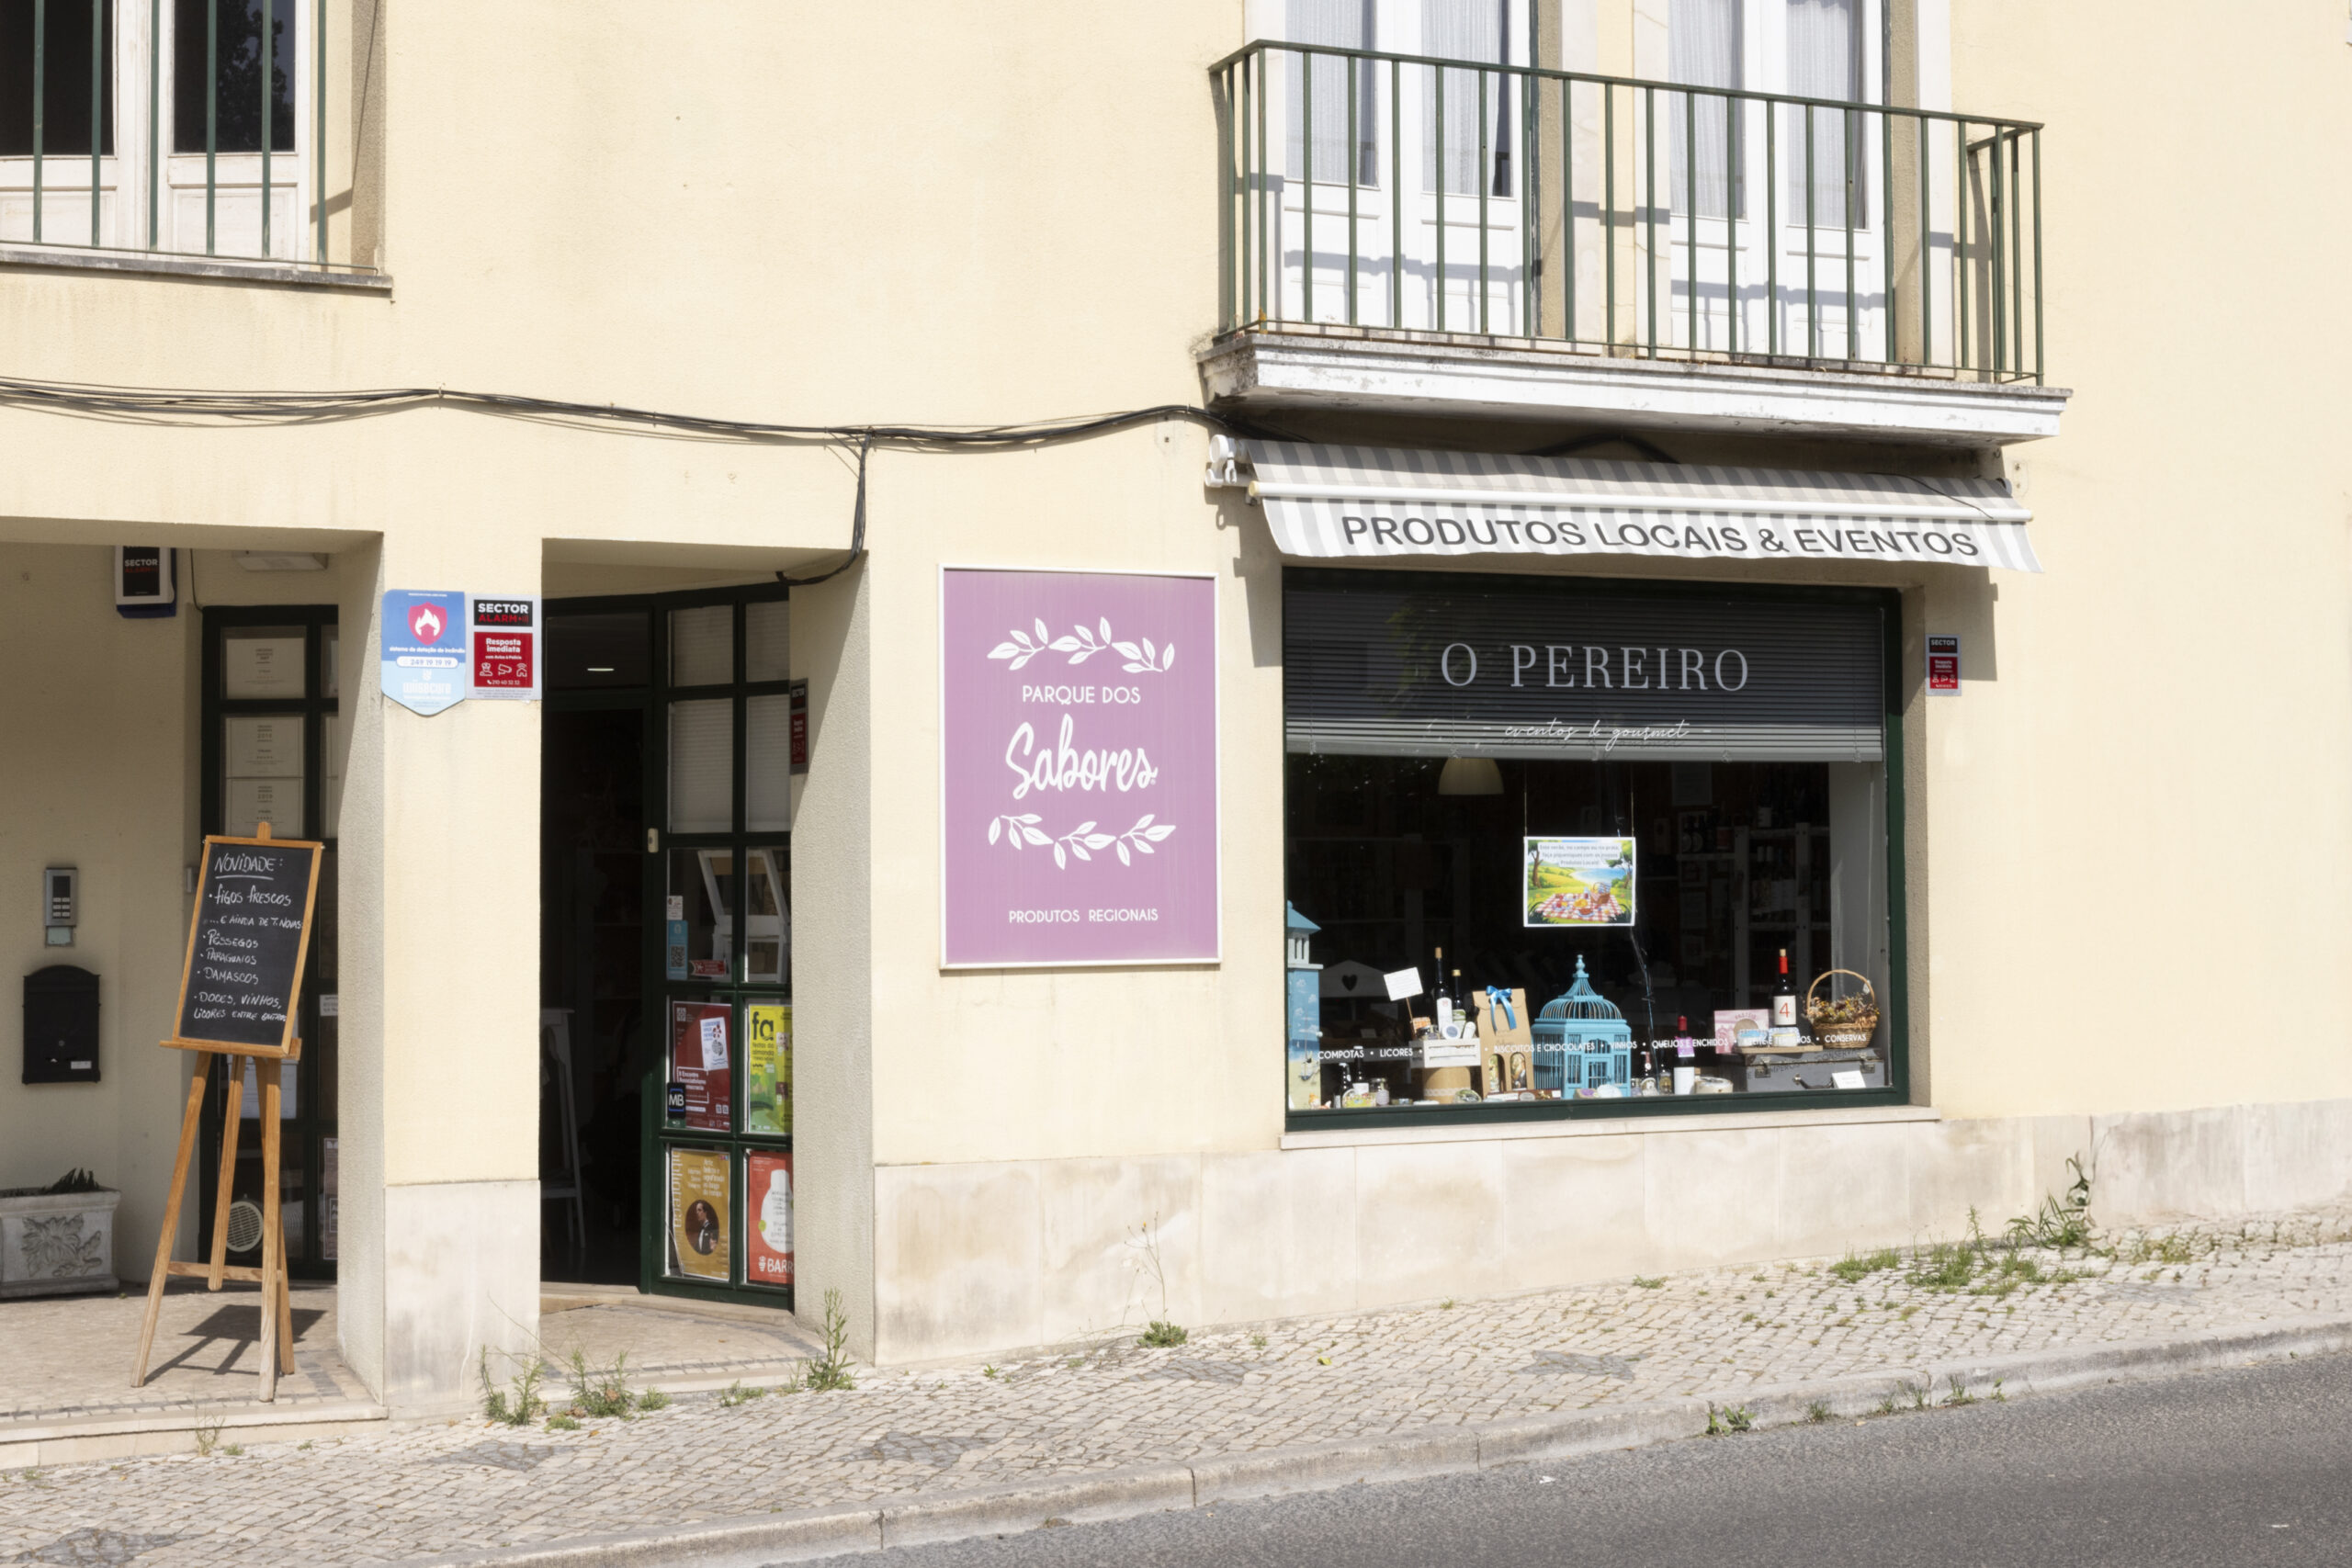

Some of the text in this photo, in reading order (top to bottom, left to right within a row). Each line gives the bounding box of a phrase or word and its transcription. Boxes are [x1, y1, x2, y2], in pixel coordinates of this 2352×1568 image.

[1342, 516, 1979, 556] PRODUTOS LOCAIS & EVENTOS
[125, 558, 158, 567] SECTOR
[478, 603, 528, 614] SECTOR
[479, 614, 517, 623] ALARM
[486, 637, 521, 646] Resposta
[487, 645, 521, 653] imediata
[1441, 643, 1748, 692] O PEREIRO
[1023, 685, 1141, 705] PARQUE DOS
[1505, 717, 1578, 739] eventos
[1605, 719, 1690, 751] gourmet
[1005, 713, 1159, 800] Sabores
[1009, 908, 1159, 923] PRODUTOS REGIONAIS
[203, 966, 259, 985] DAMASCOS
[1779, 1002, 1790, 1017] 4
[752, 1011, 774, 1041] fa
[1494, 1043, 1535, 1054] BISCOITOS
[1544, 1043, 1595, 1052] CHOCOLATES
[1610, 1041, 1637, 1050] VINHOS
[1652, 1039, 1684, 1049] QUEIJOS
[1692, 1038, 1728, 1047] ENCHIDOS
[1825, 1034, 1867, 1043] CONSERVAS
[1317, 1048, 1413, 1060] COMPOTAS LICORES
[669, 1094, 684, 1106] MB
